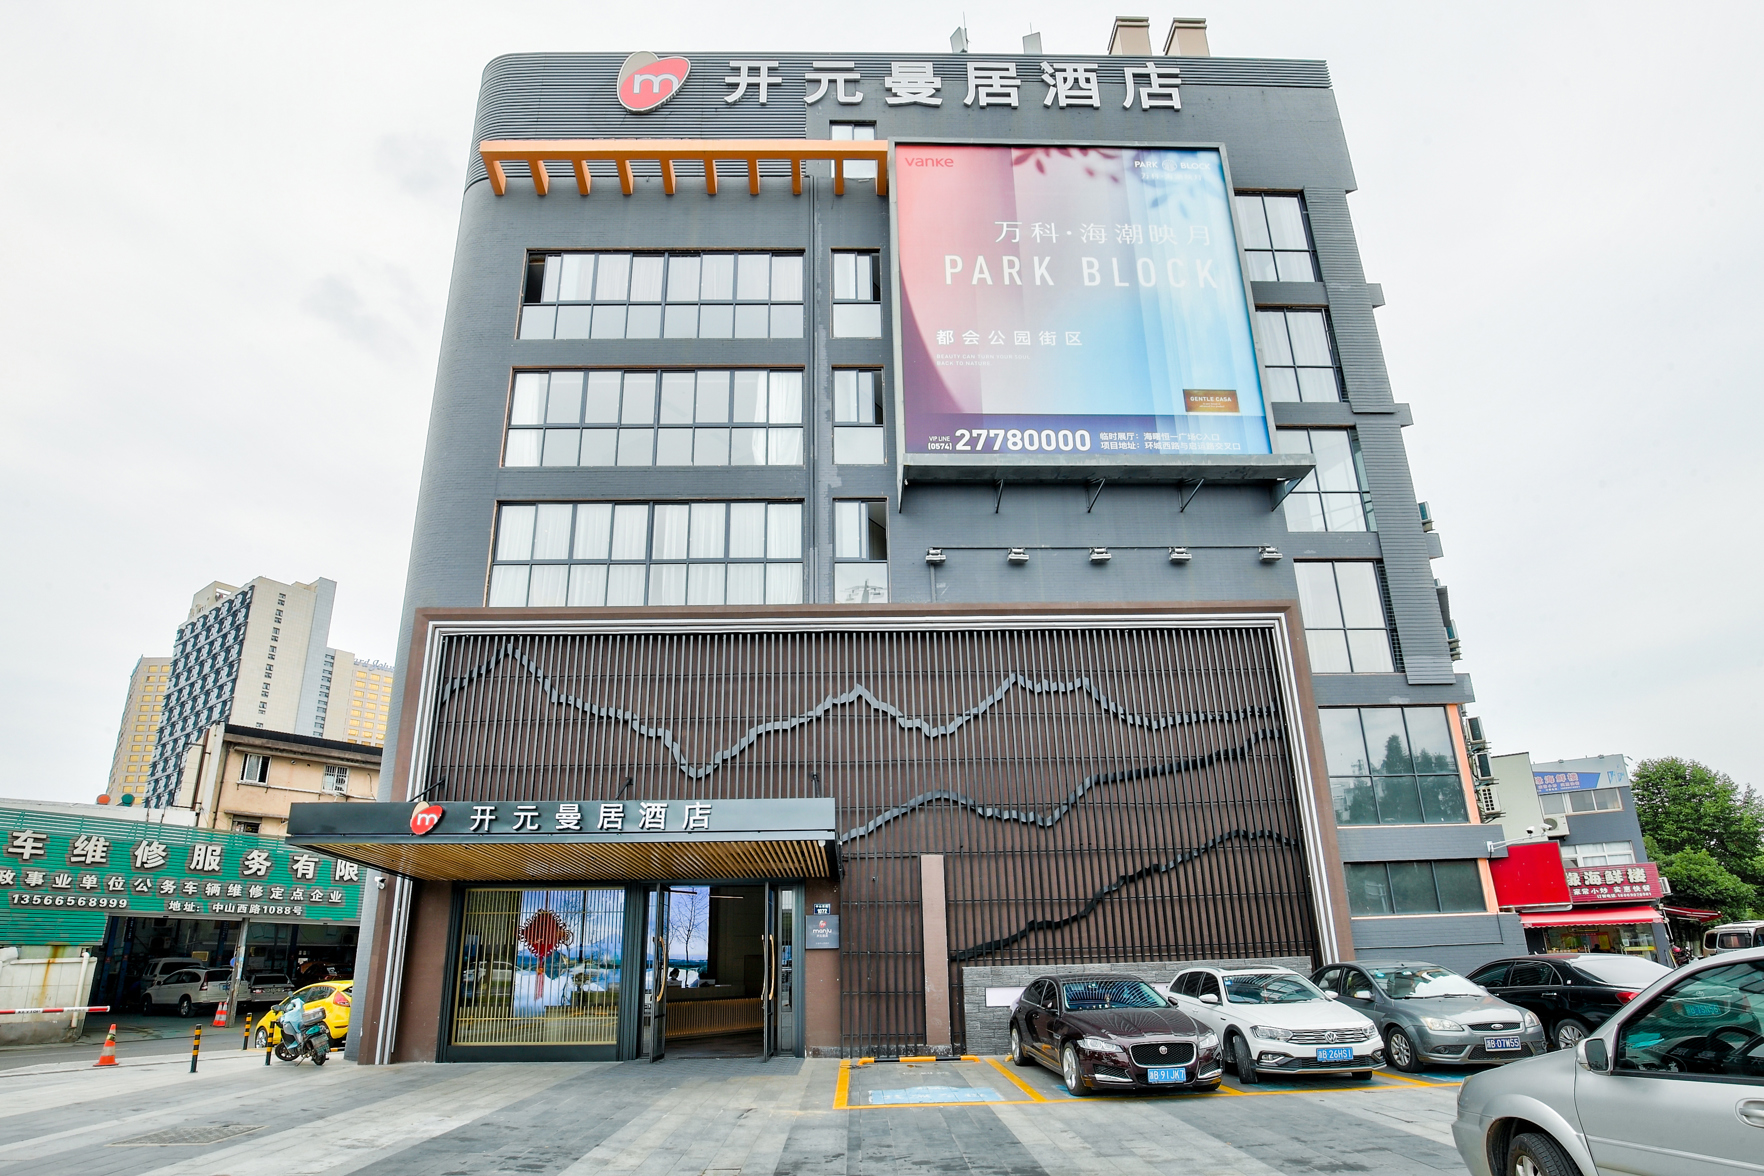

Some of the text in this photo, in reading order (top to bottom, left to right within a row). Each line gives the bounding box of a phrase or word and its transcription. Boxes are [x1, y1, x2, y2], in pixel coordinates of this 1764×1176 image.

[724, 60, 1182, 111] 开元曼居酒店
[904, 157, 954, 167] vanke
[1134, 160, 1211, 170] PARK BLOCK
[944, 255, 1219, 288] PARK BLOCK
[936, 329, 1083, 346] 都会公园街区
[954, 429, 1091, 451] 27780000
[469, 801, 712, 831] 开元曼居酒店
[7, 829, 360, 882] 车维修服务有限
[12, 893, 128, 909] 13566568999
